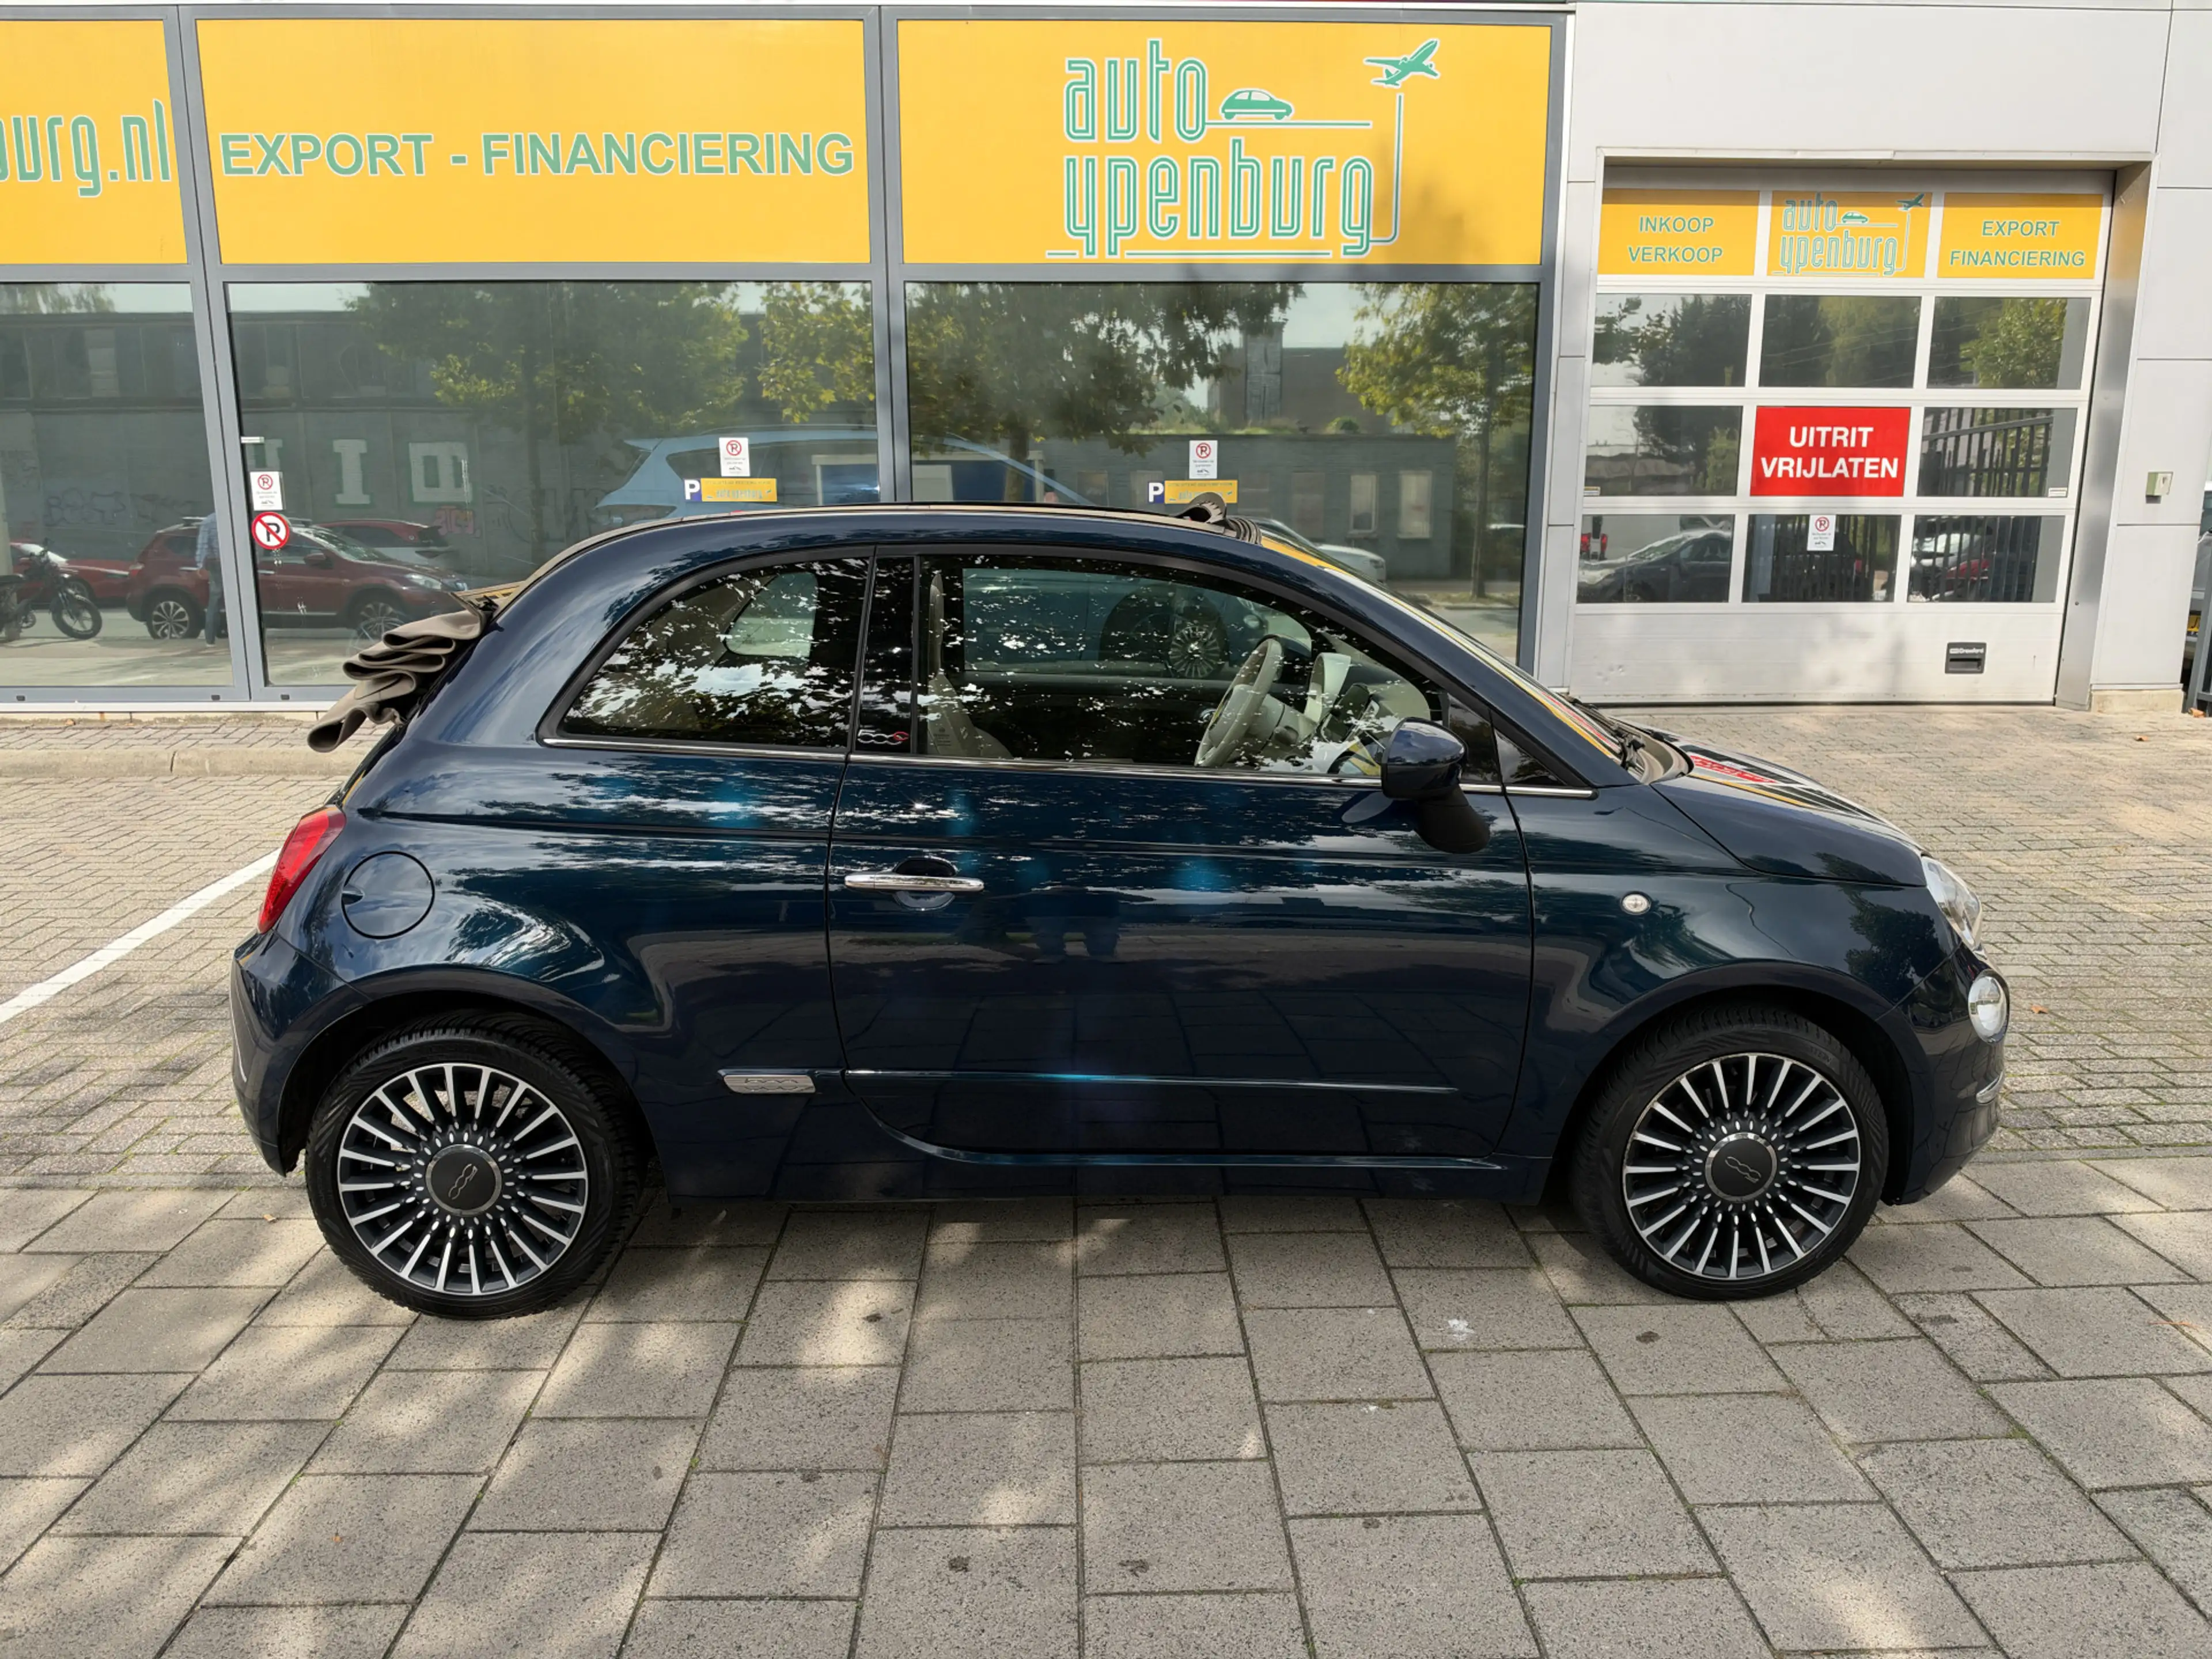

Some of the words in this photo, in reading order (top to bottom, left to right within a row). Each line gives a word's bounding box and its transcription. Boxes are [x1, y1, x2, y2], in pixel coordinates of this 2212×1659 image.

[1063, 37, 1207, 143] auto
[220, 133, 433, 176] EXPORT
[482, 132, 854, 176] FINANCIERING
[1063, 137, 1373, 258] ypenburg
[1783, 192, 1838, 230] auto
[1639, 216, 1714, 233] INKOOP
[1982, 221, 2061, 237] EXPORT
[1627, 247, 1723, 263] VERKOOP
[1780, 230, 1897, 276] ypenburg
[1949, 250, 2085, 267] FINANCIERING
[1789, 426, 1874, 448] UITRIT
[1760, 457, 1899, 478] VRIJLATEN
[684, 479, 701, 500] P
[1148, 482, 1164, 502] P
